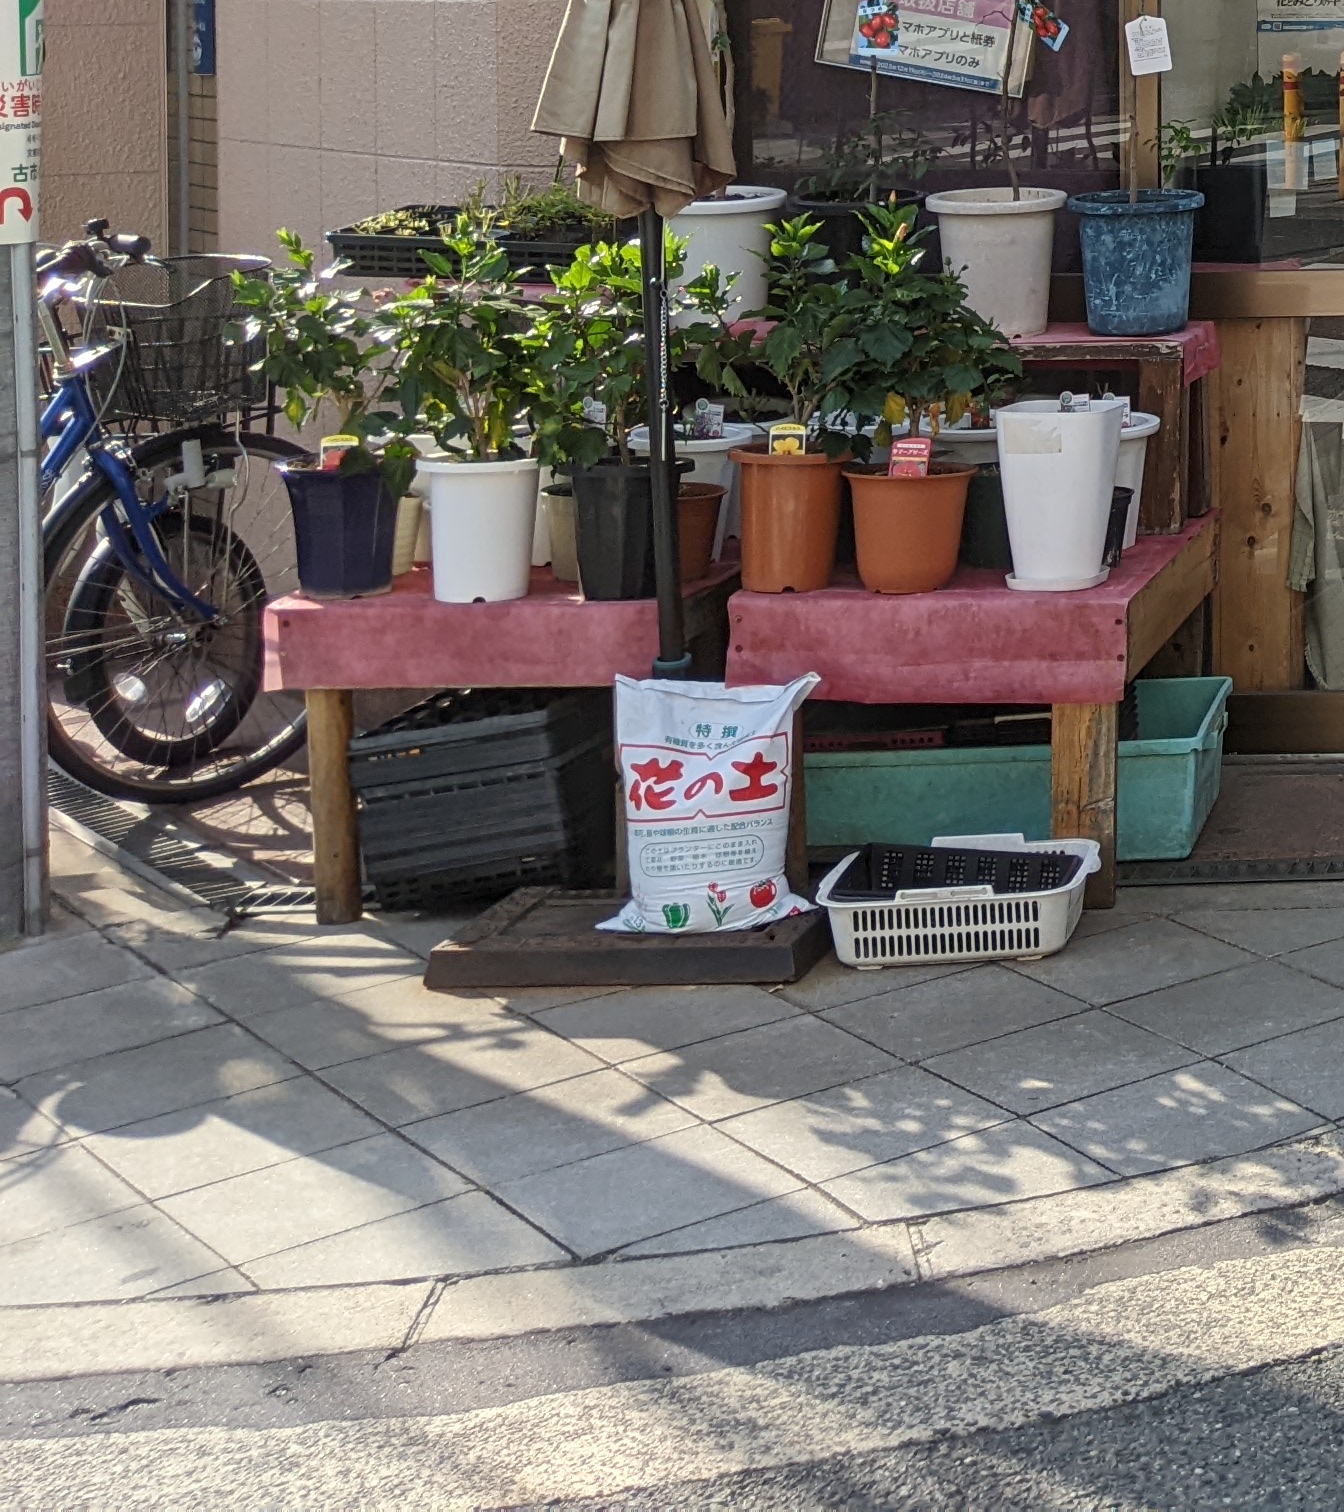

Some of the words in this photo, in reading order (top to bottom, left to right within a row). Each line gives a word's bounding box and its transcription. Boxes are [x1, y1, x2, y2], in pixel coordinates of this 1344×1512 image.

[898, 21, 996, 48] マホアプリと紙券
[898, 45, 981, 69] マホアプリのみ
[629, 751, 778, 811] 花の土
